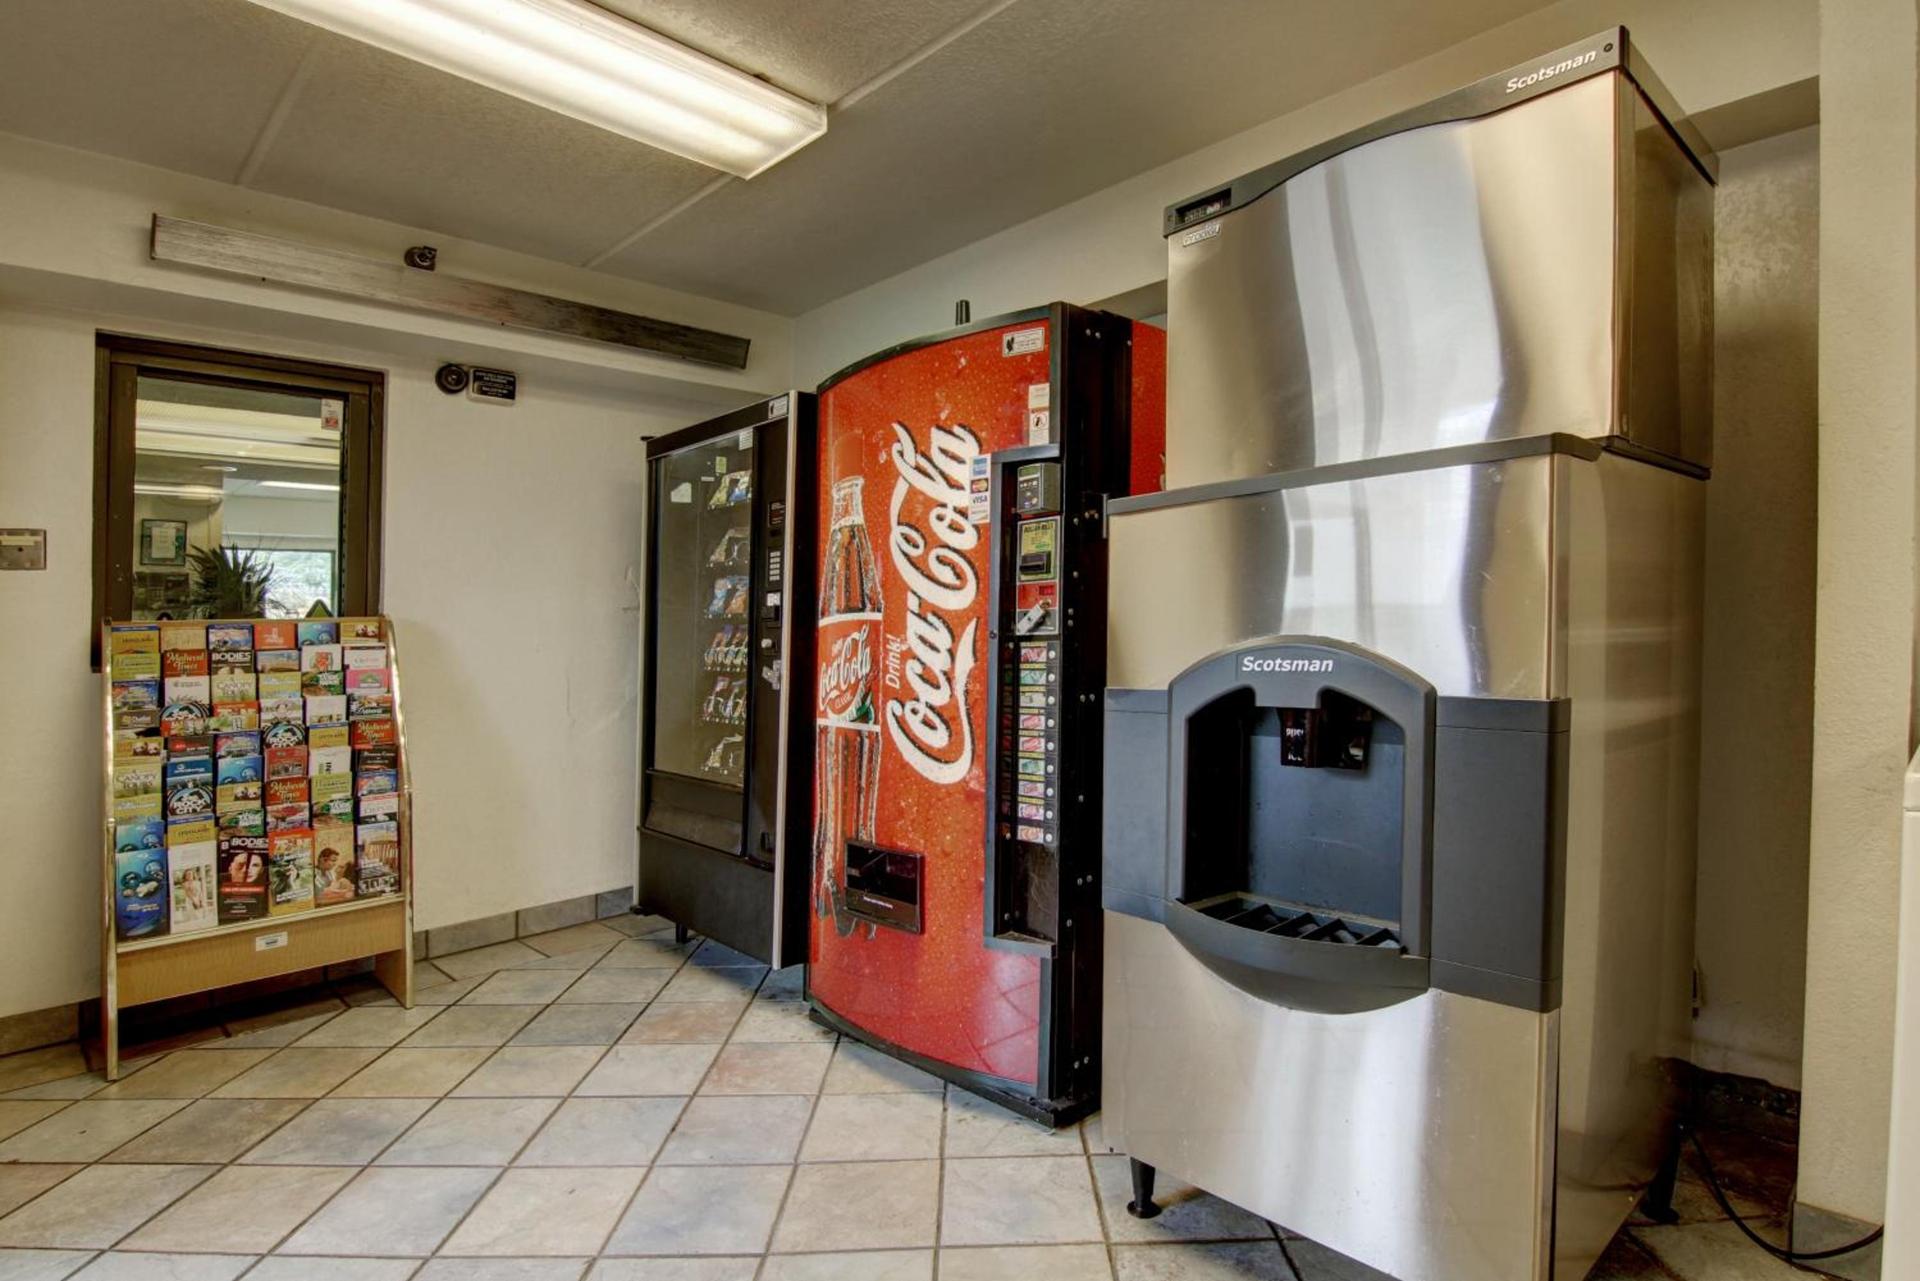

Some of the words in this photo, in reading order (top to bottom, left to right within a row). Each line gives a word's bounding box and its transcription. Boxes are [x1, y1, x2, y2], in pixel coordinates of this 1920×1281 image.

[1505, 50, 1597, 93] Scotsman
[886, 420, 980, 785] Coca-Cola
[212, 651, 252, 662] BODIES
[1241, 656, 1334, 672] Scotsman
[173, 799, 207, 810] ROCK
[176, 806, 204, 816] CITY
